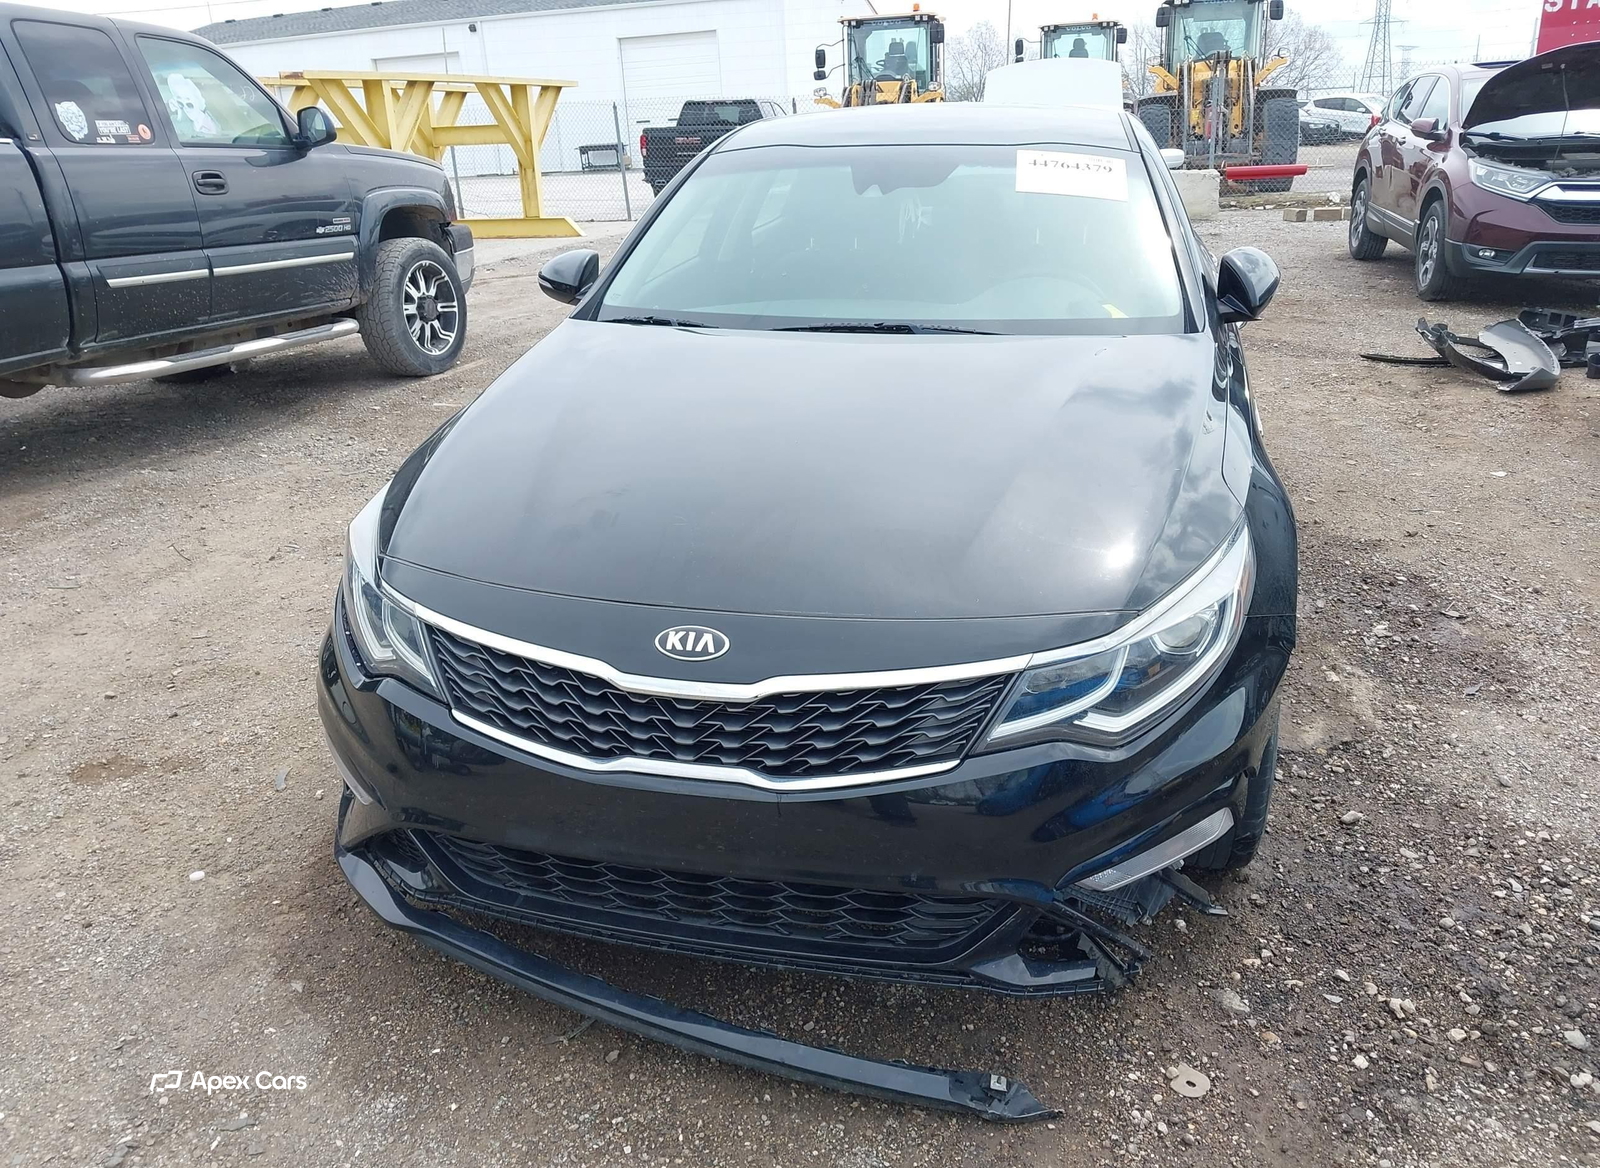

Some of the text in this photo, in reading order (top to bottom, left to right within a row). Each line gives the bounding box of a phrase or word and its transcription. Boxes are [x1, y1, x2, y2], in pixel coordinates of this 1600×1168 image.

[1028, 158, 1113, 173] 44764379
[324, 224, 343, 233] 2500
[665, 630, 715, 653] KIA
